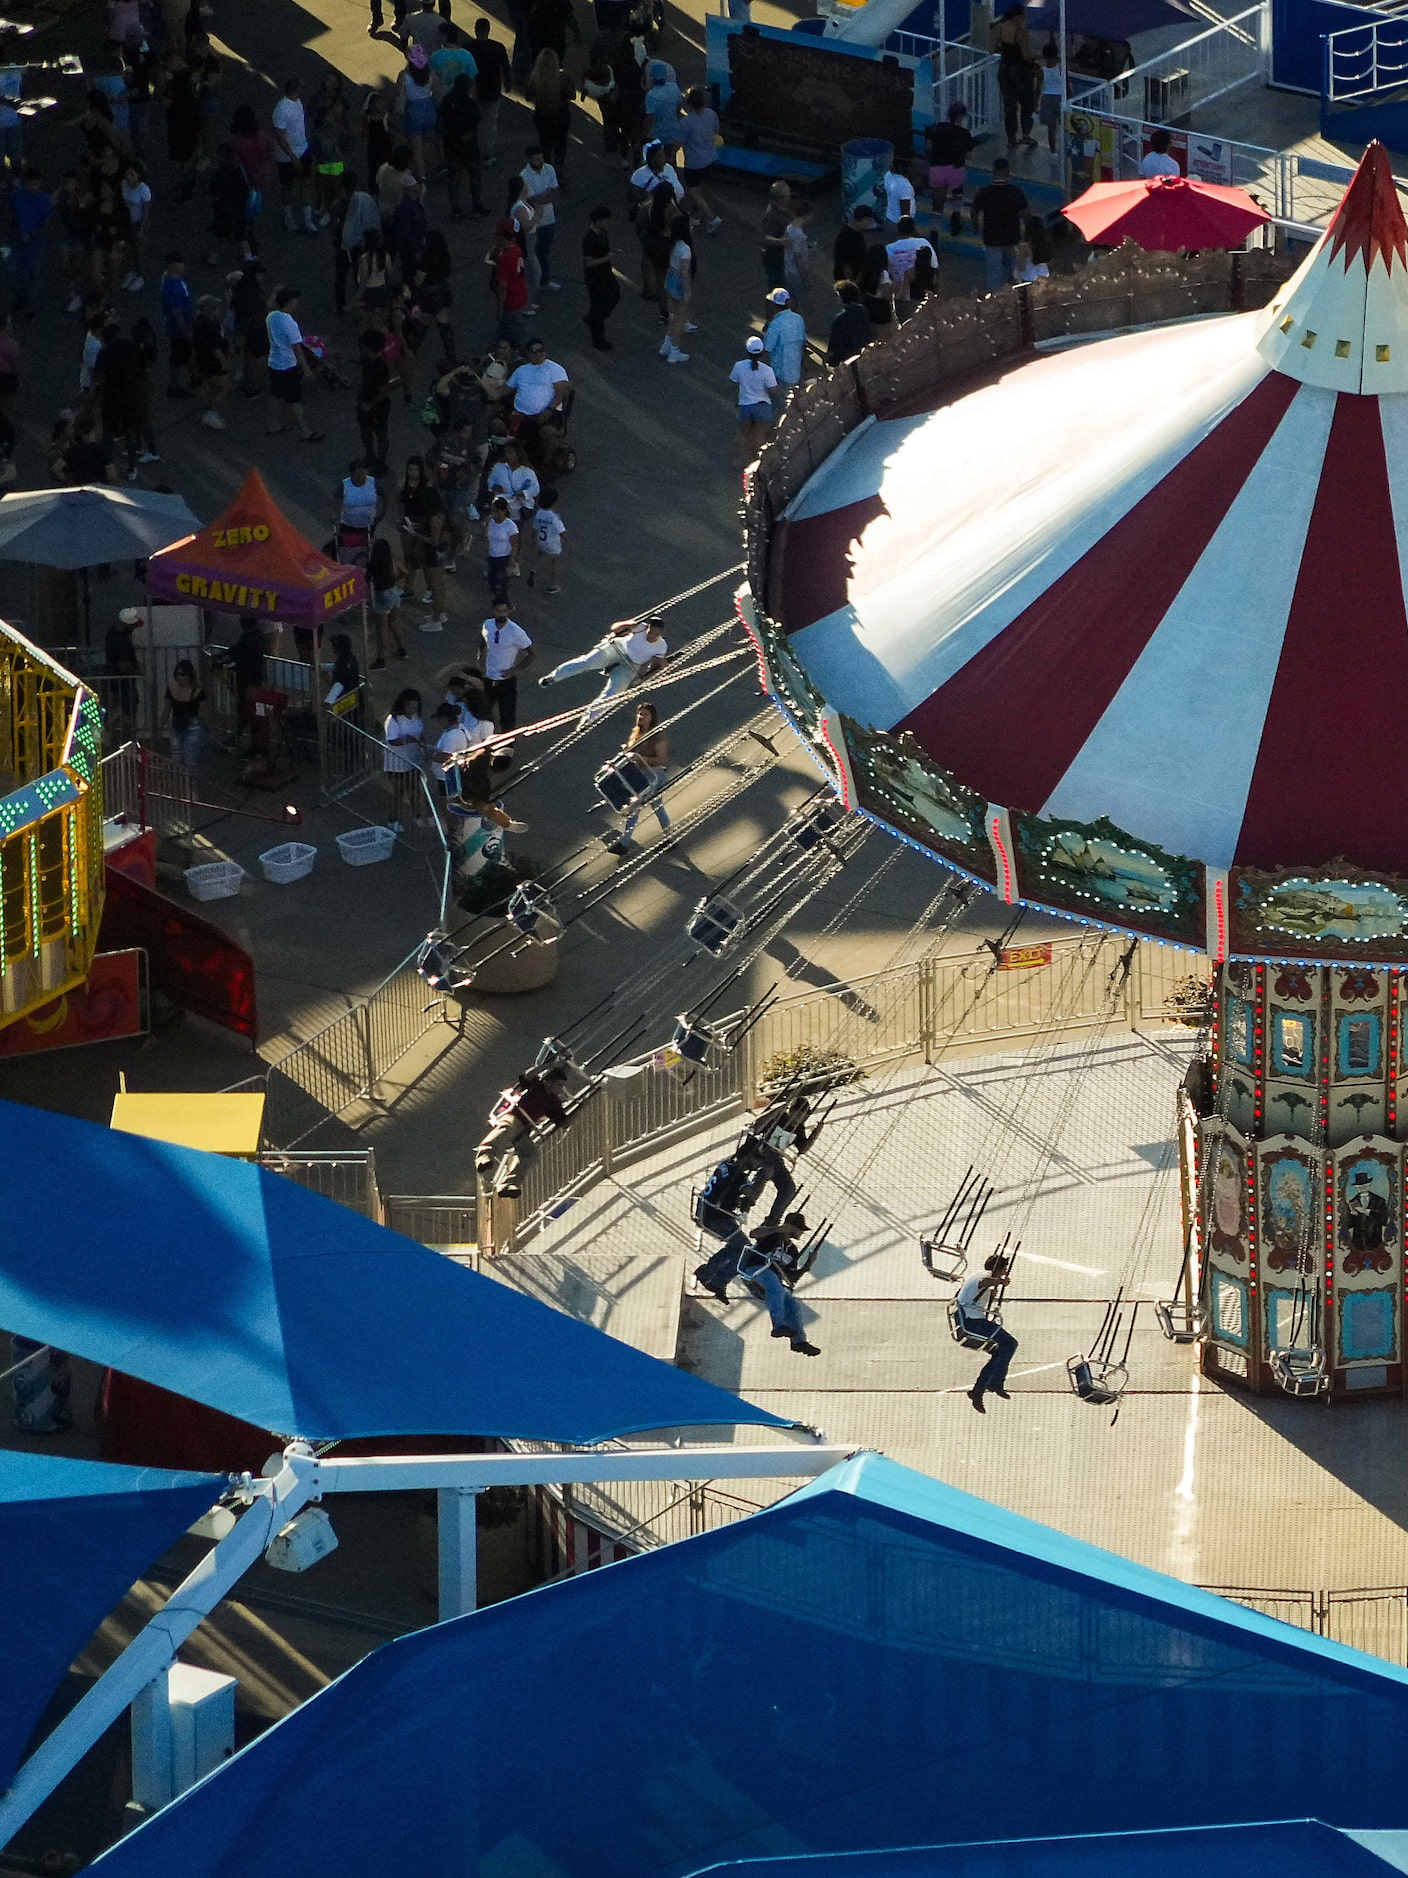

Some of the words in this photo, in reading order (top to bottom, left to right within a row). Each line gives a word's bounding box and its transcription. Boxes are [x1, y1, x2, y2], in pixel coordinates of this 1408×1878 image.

[212, 525, 270, 548] ZERO
[176, 573, 279, 611] GRAVITY
[323, 578, 356, 609] EXIT
[1010, 947, 1044, 962] EXIT
